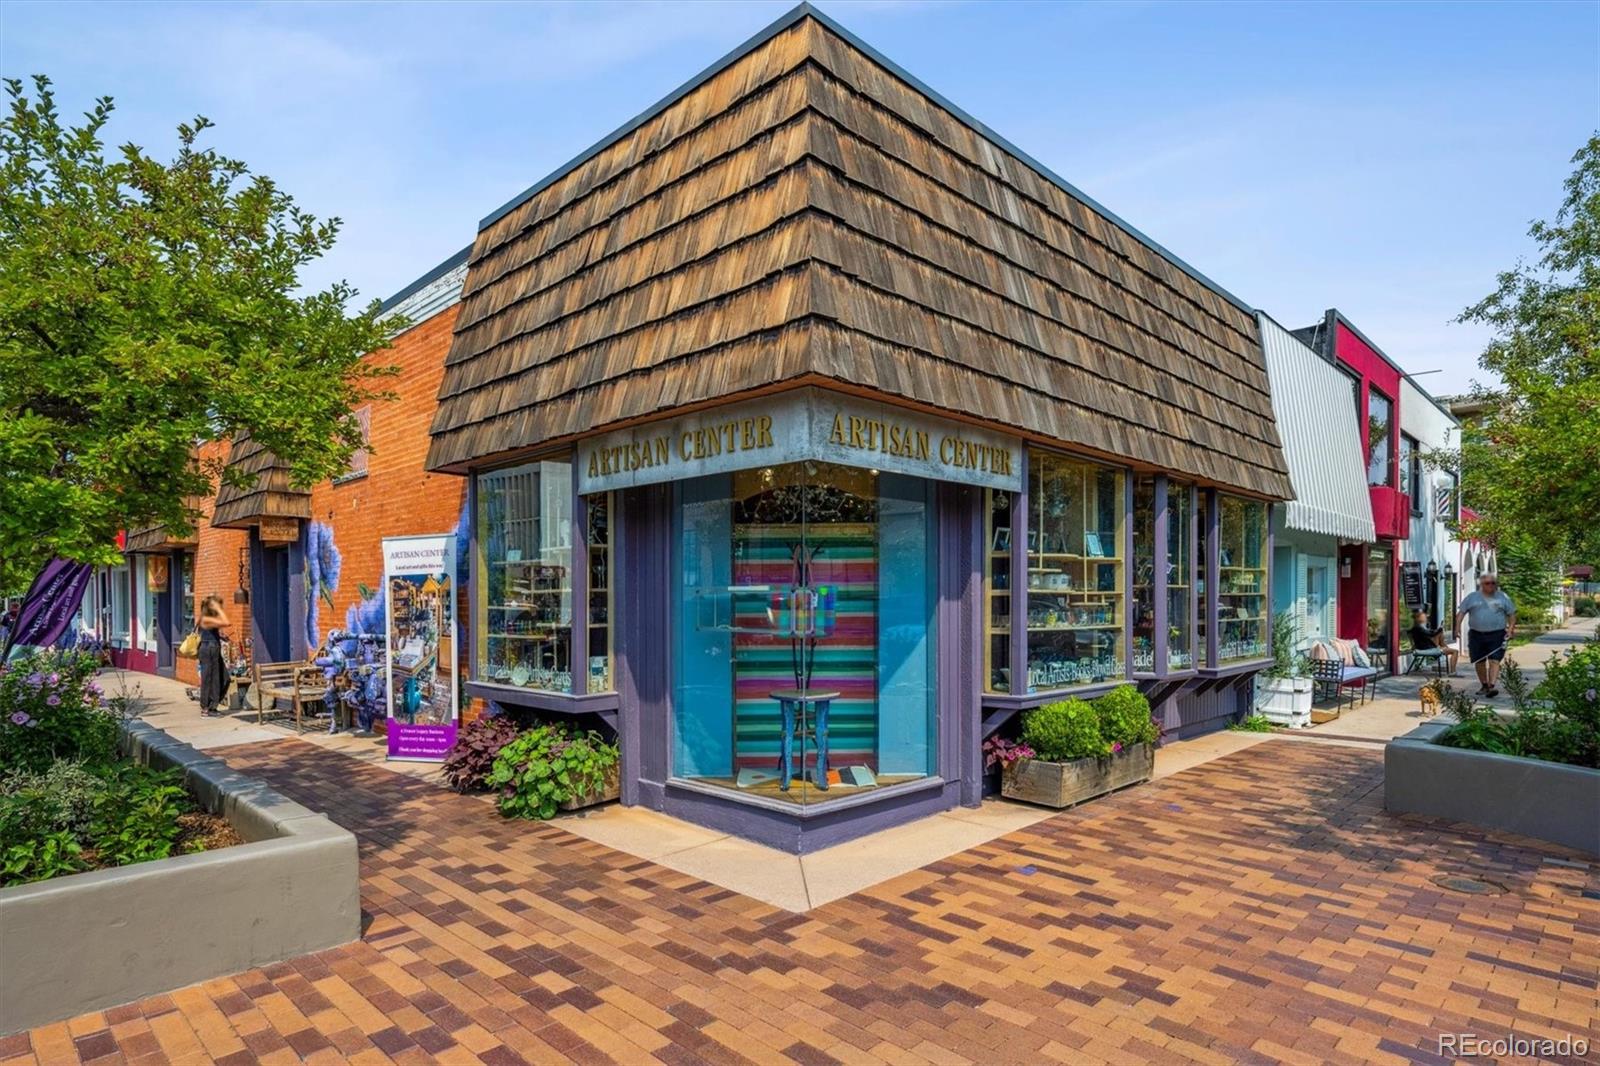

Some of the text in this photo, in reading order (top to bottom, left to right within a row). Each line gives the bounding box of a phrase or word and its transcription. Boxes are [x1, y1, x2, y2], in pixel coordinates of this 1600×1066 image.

[587, 414, 774, 479] ARTISAN CENTER
[829, 413, 1013, 476] ARTISAN CENTER
[390, 548, 450, 559] ARTISAN CENTER
